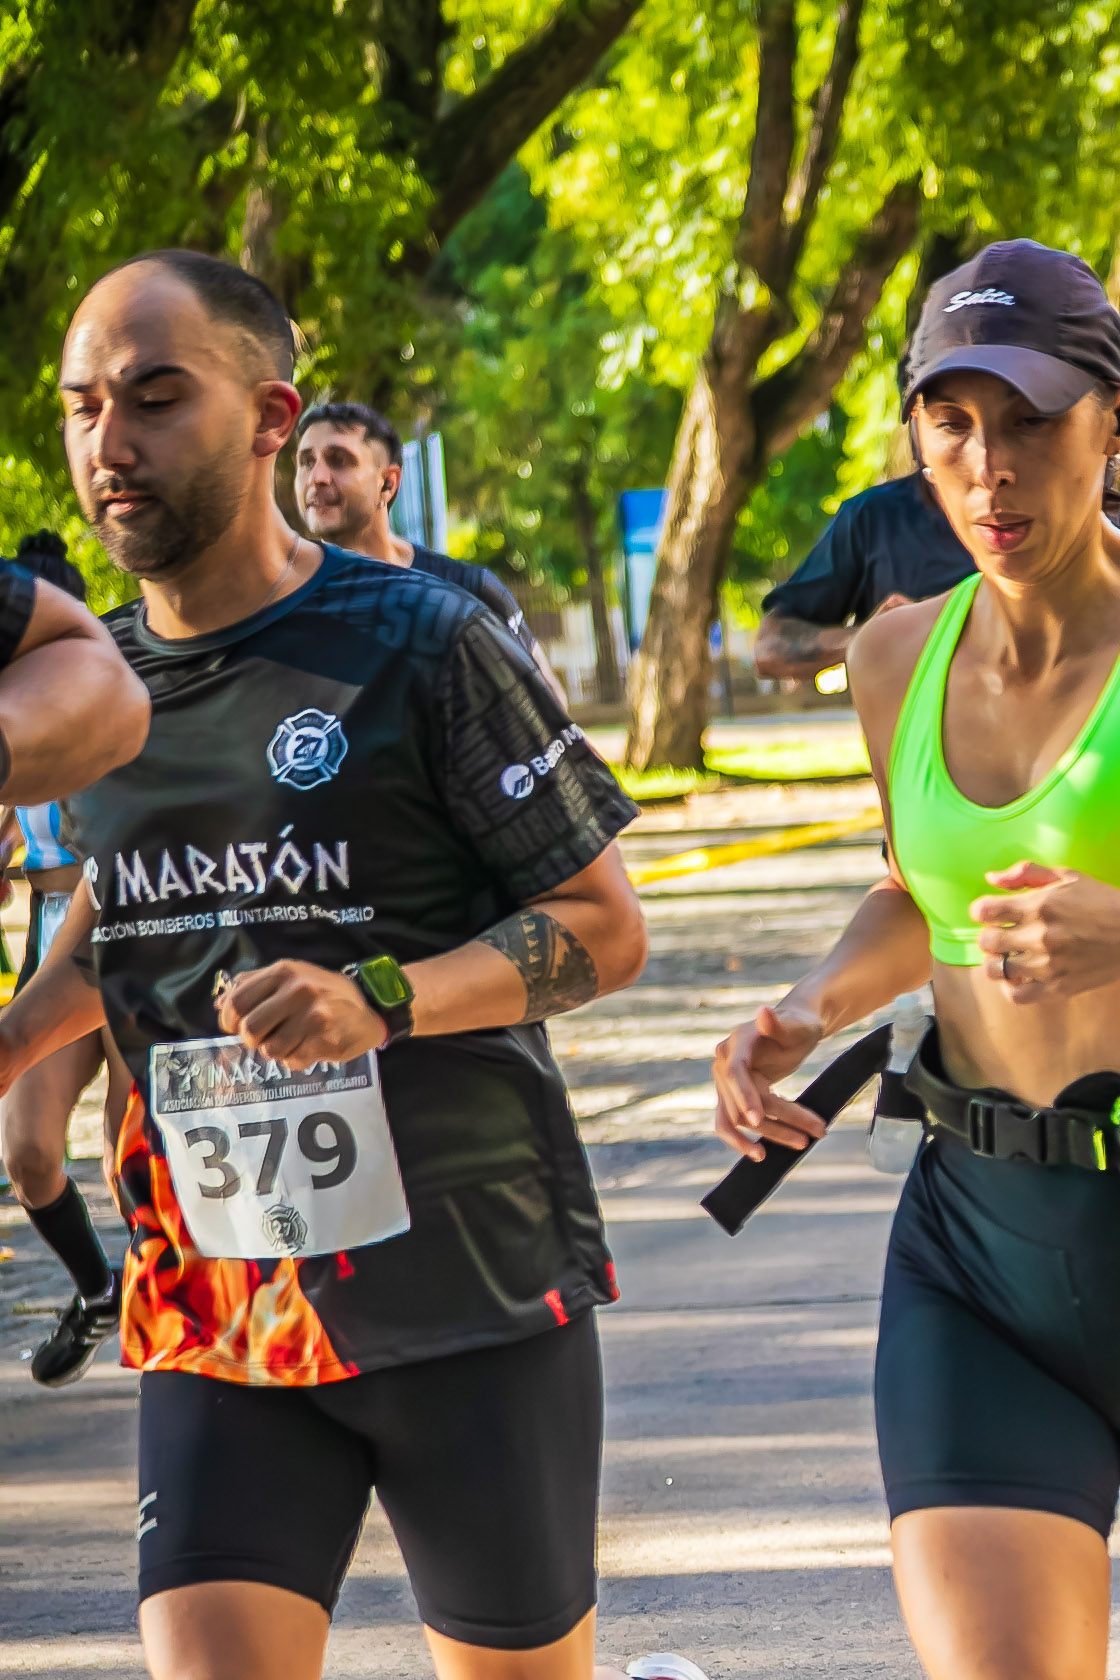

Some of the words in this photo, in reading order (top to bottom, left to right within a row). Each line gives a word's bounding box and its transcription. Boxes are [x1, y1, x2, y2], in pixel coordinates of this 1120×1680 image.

[115, 823, 350, 906] MARATÓN
[137, 912, 215, 938] BOMBEROS
[184, 1111, 358, 1199] 379
